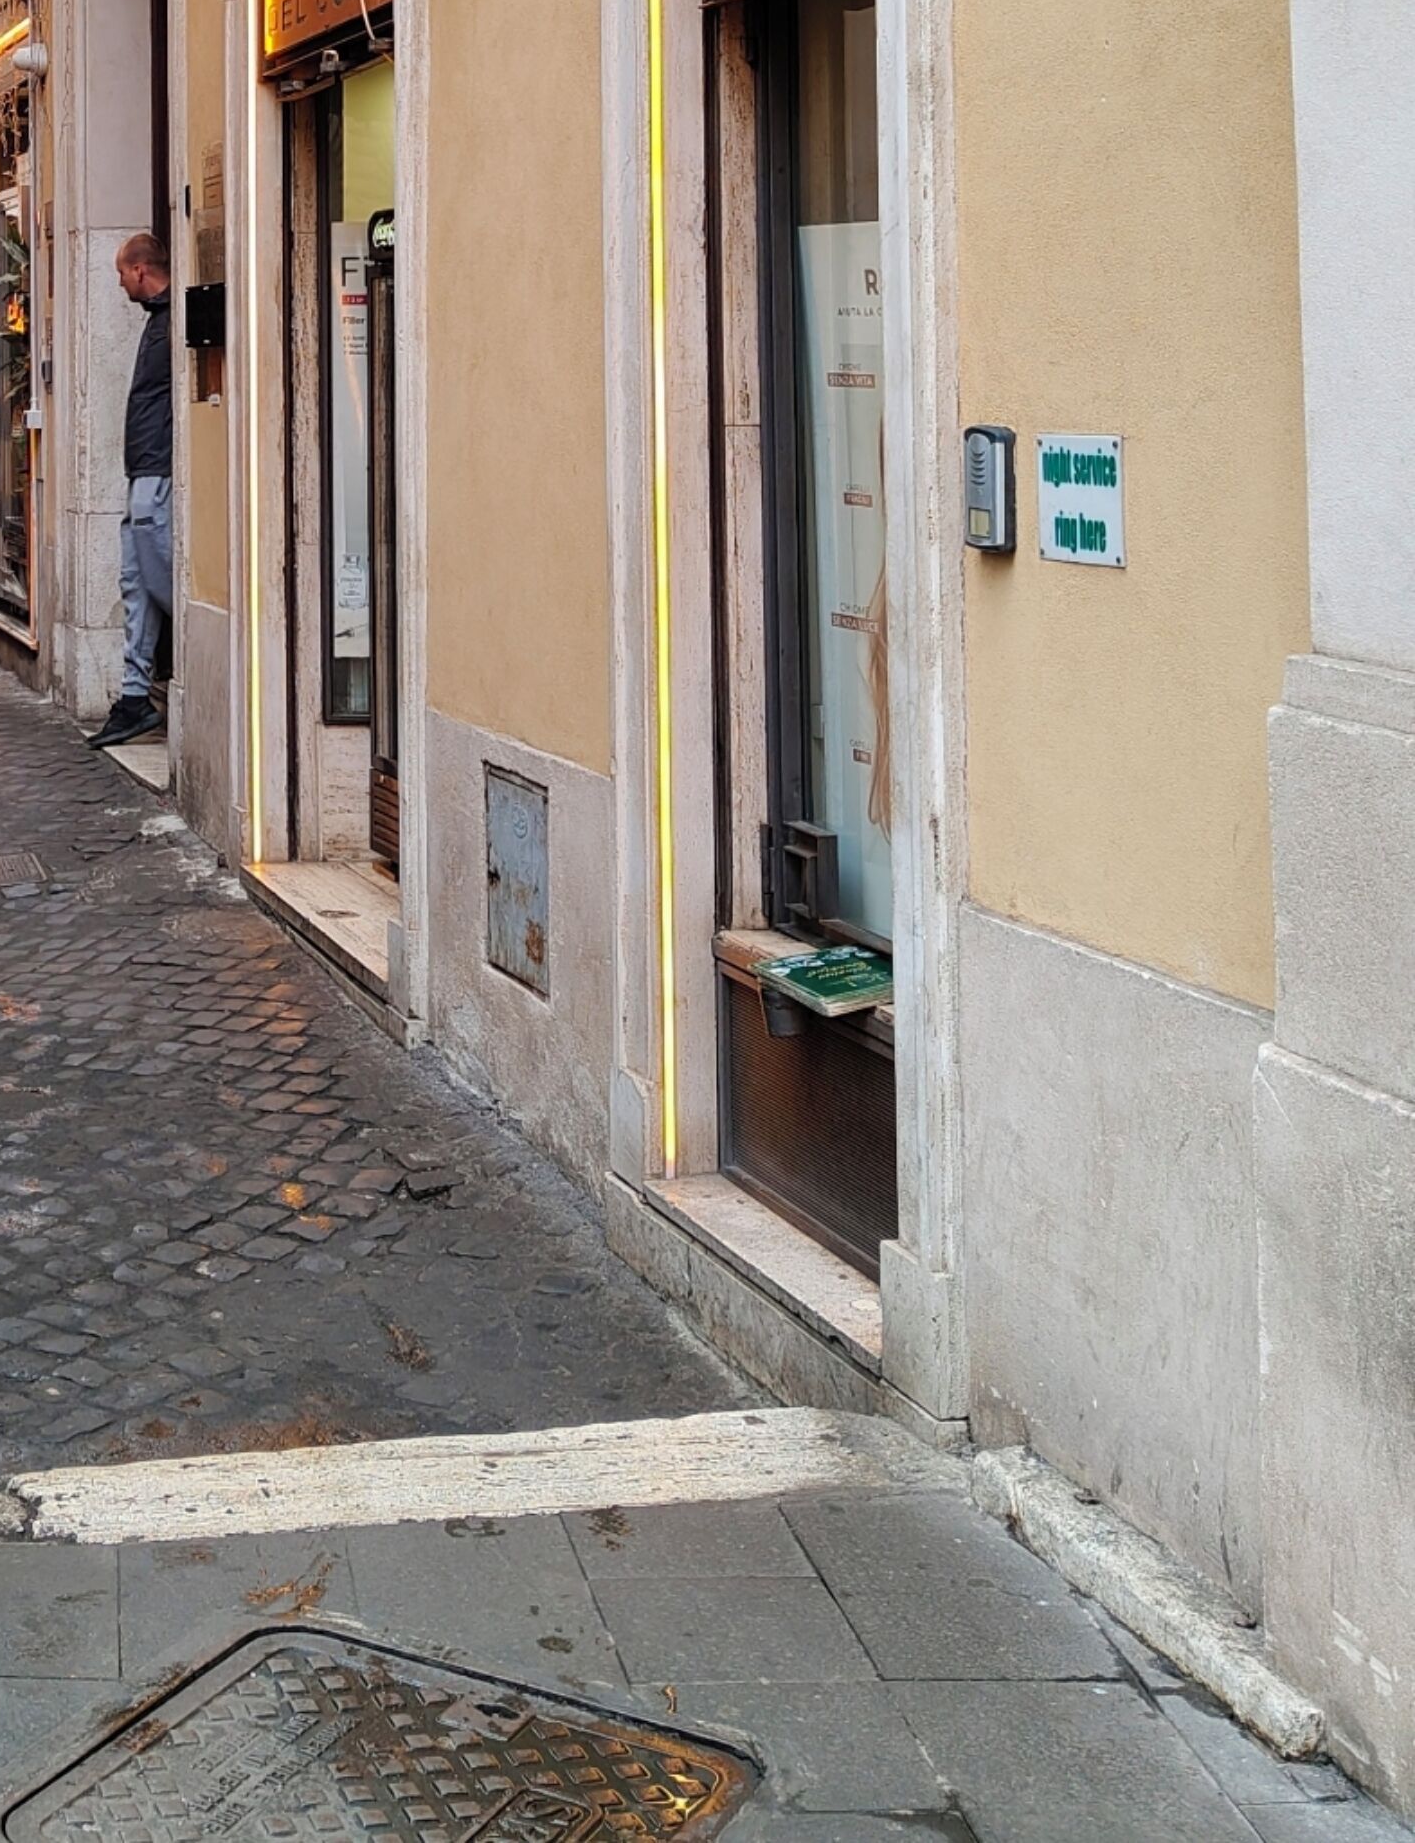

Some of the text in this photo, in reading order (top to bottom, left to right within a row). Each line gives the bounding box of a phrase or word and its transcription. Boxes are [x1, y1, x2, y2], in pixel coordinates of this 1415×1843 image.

[1042, 445, 1117, 488] night service
[1055, 509, 1106, 553] ring here
